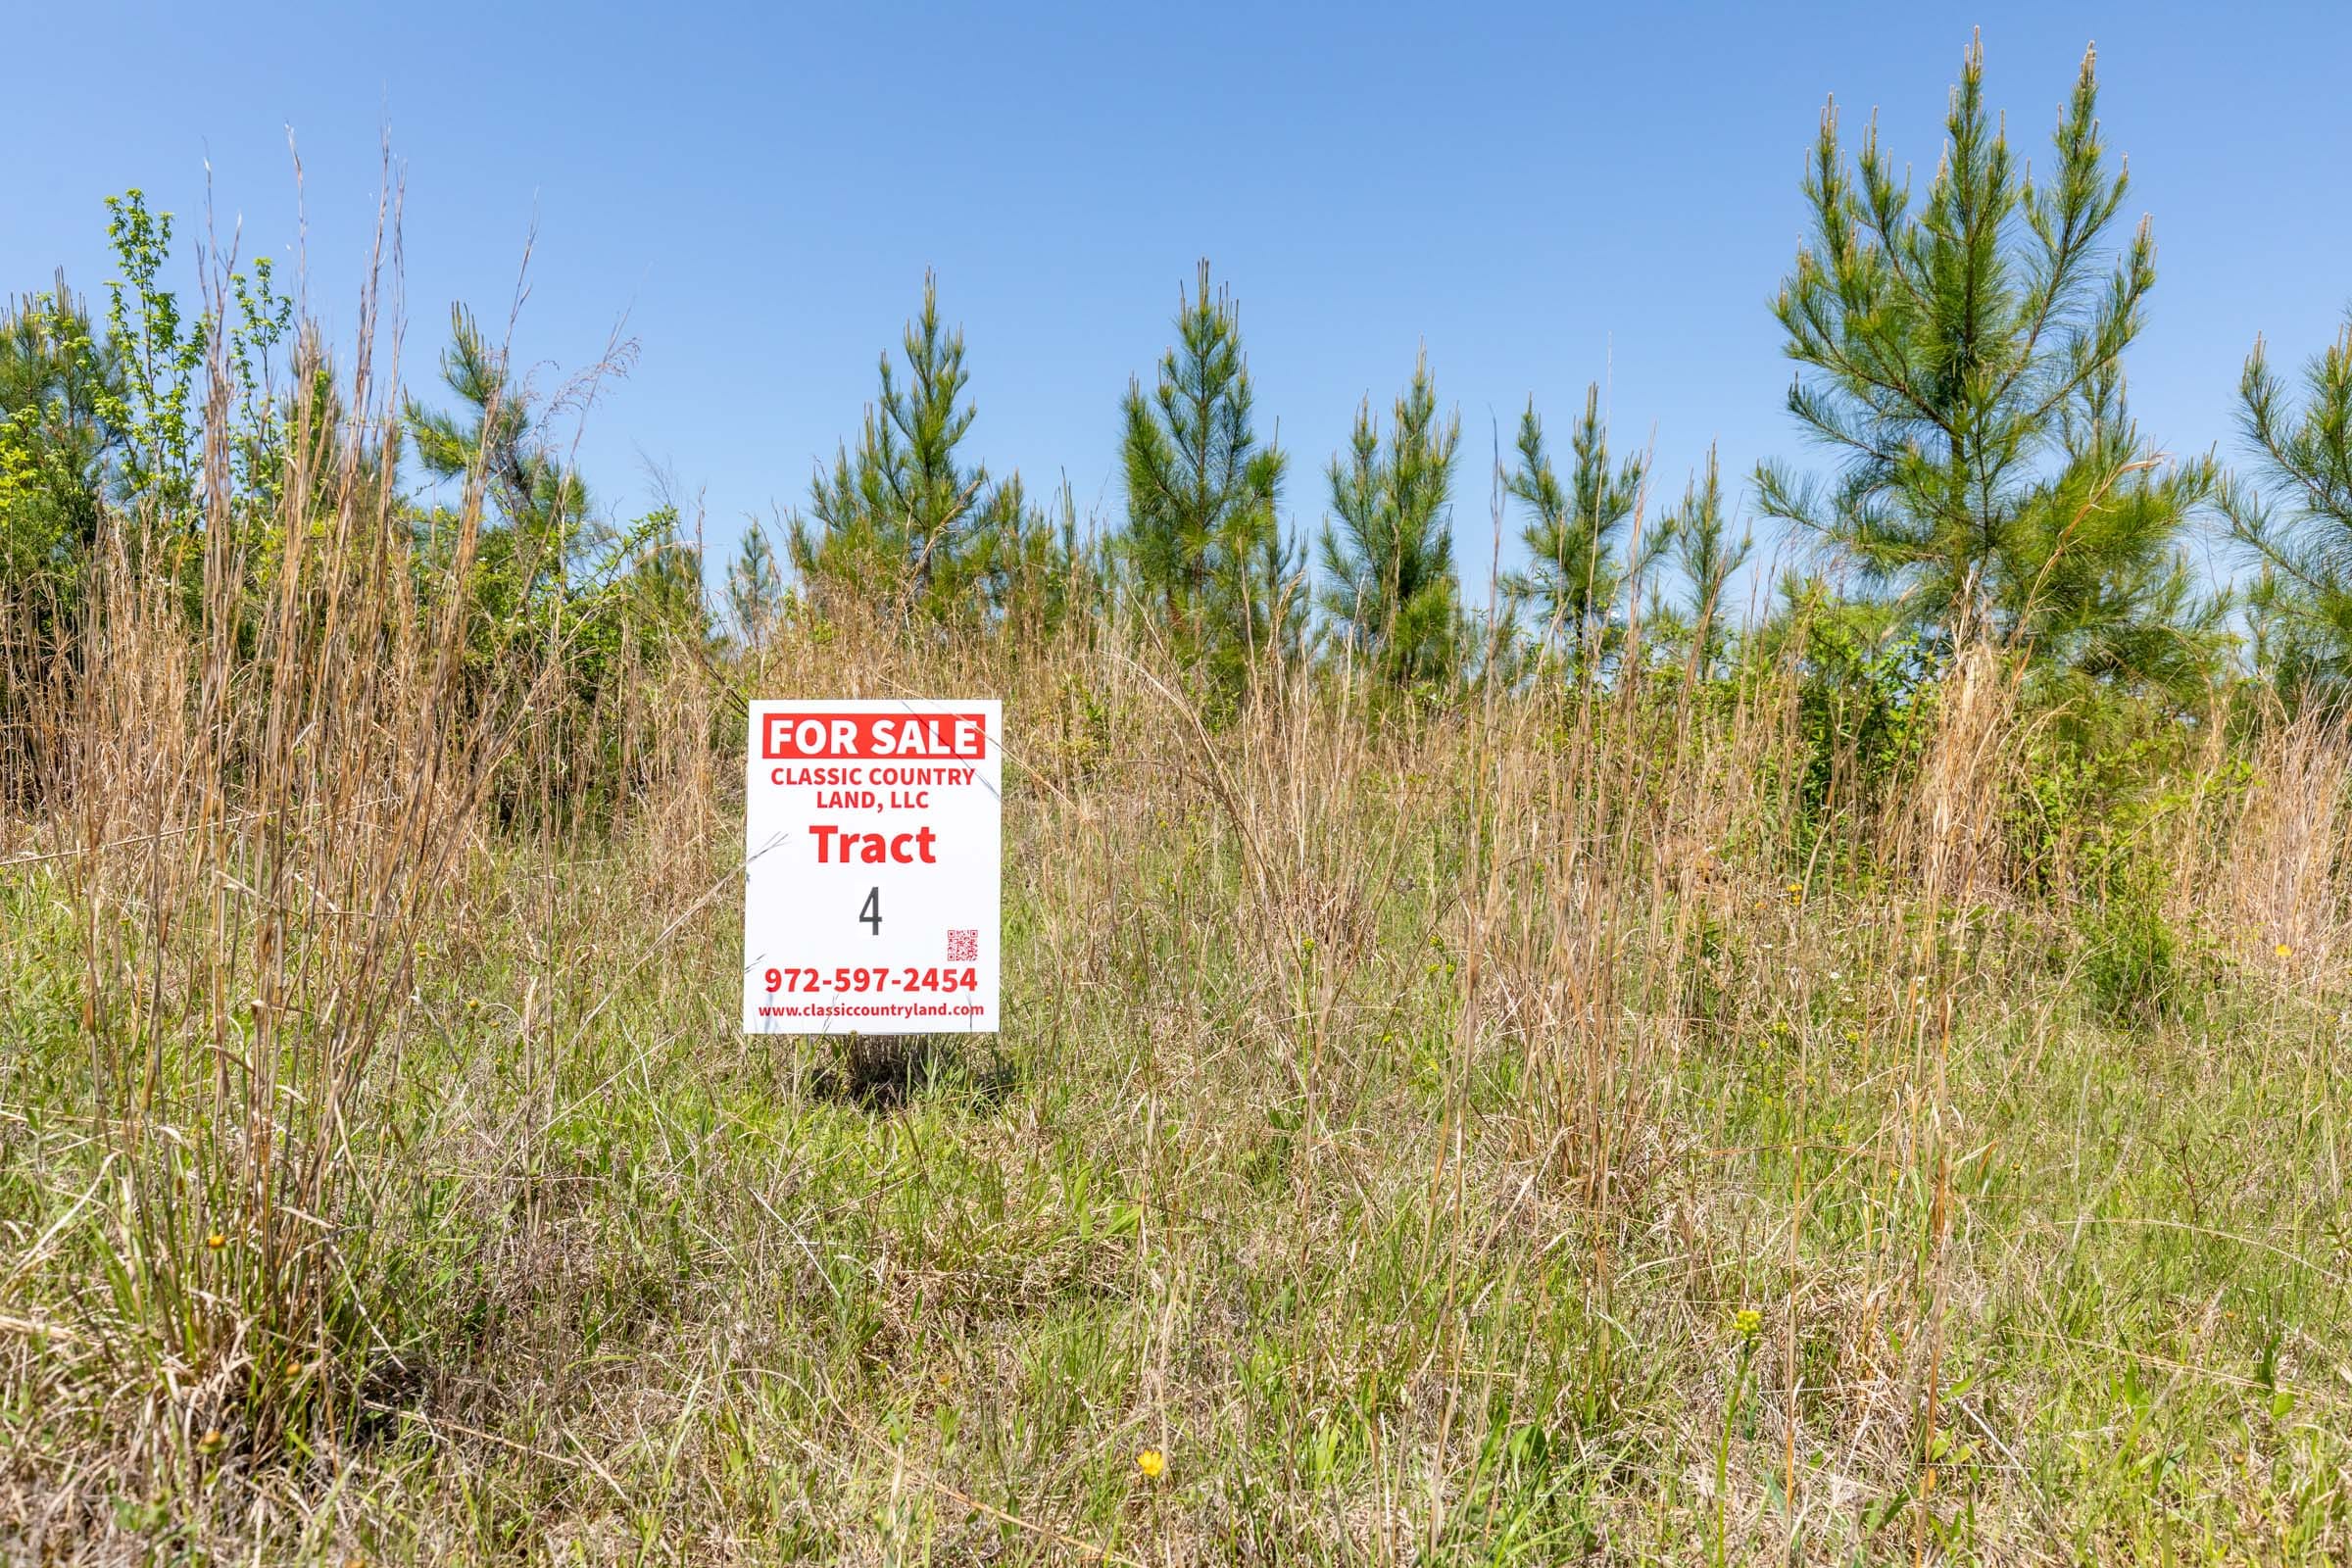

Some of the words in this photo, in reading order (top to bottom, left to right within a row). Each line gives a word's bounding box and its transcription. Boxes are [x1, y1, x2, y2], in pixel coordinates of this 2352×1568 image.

[769, 719, 858, 756] FOR
[870, 719, 978, 756] SALE
[770, 767, 862, 786] CLASSIC
[868, 767, 976, 786] COUNTRY
[816, 791, 884, 813] LAND,
[890, 791, 930, 808] LLC
[808, 824, 937, 864] Tract
[858, 886, 883, 936] 4
[764, 967, 978, 994] 972-597-2454
[759, 1003, 985, 1020] www.classiccountryland.com
